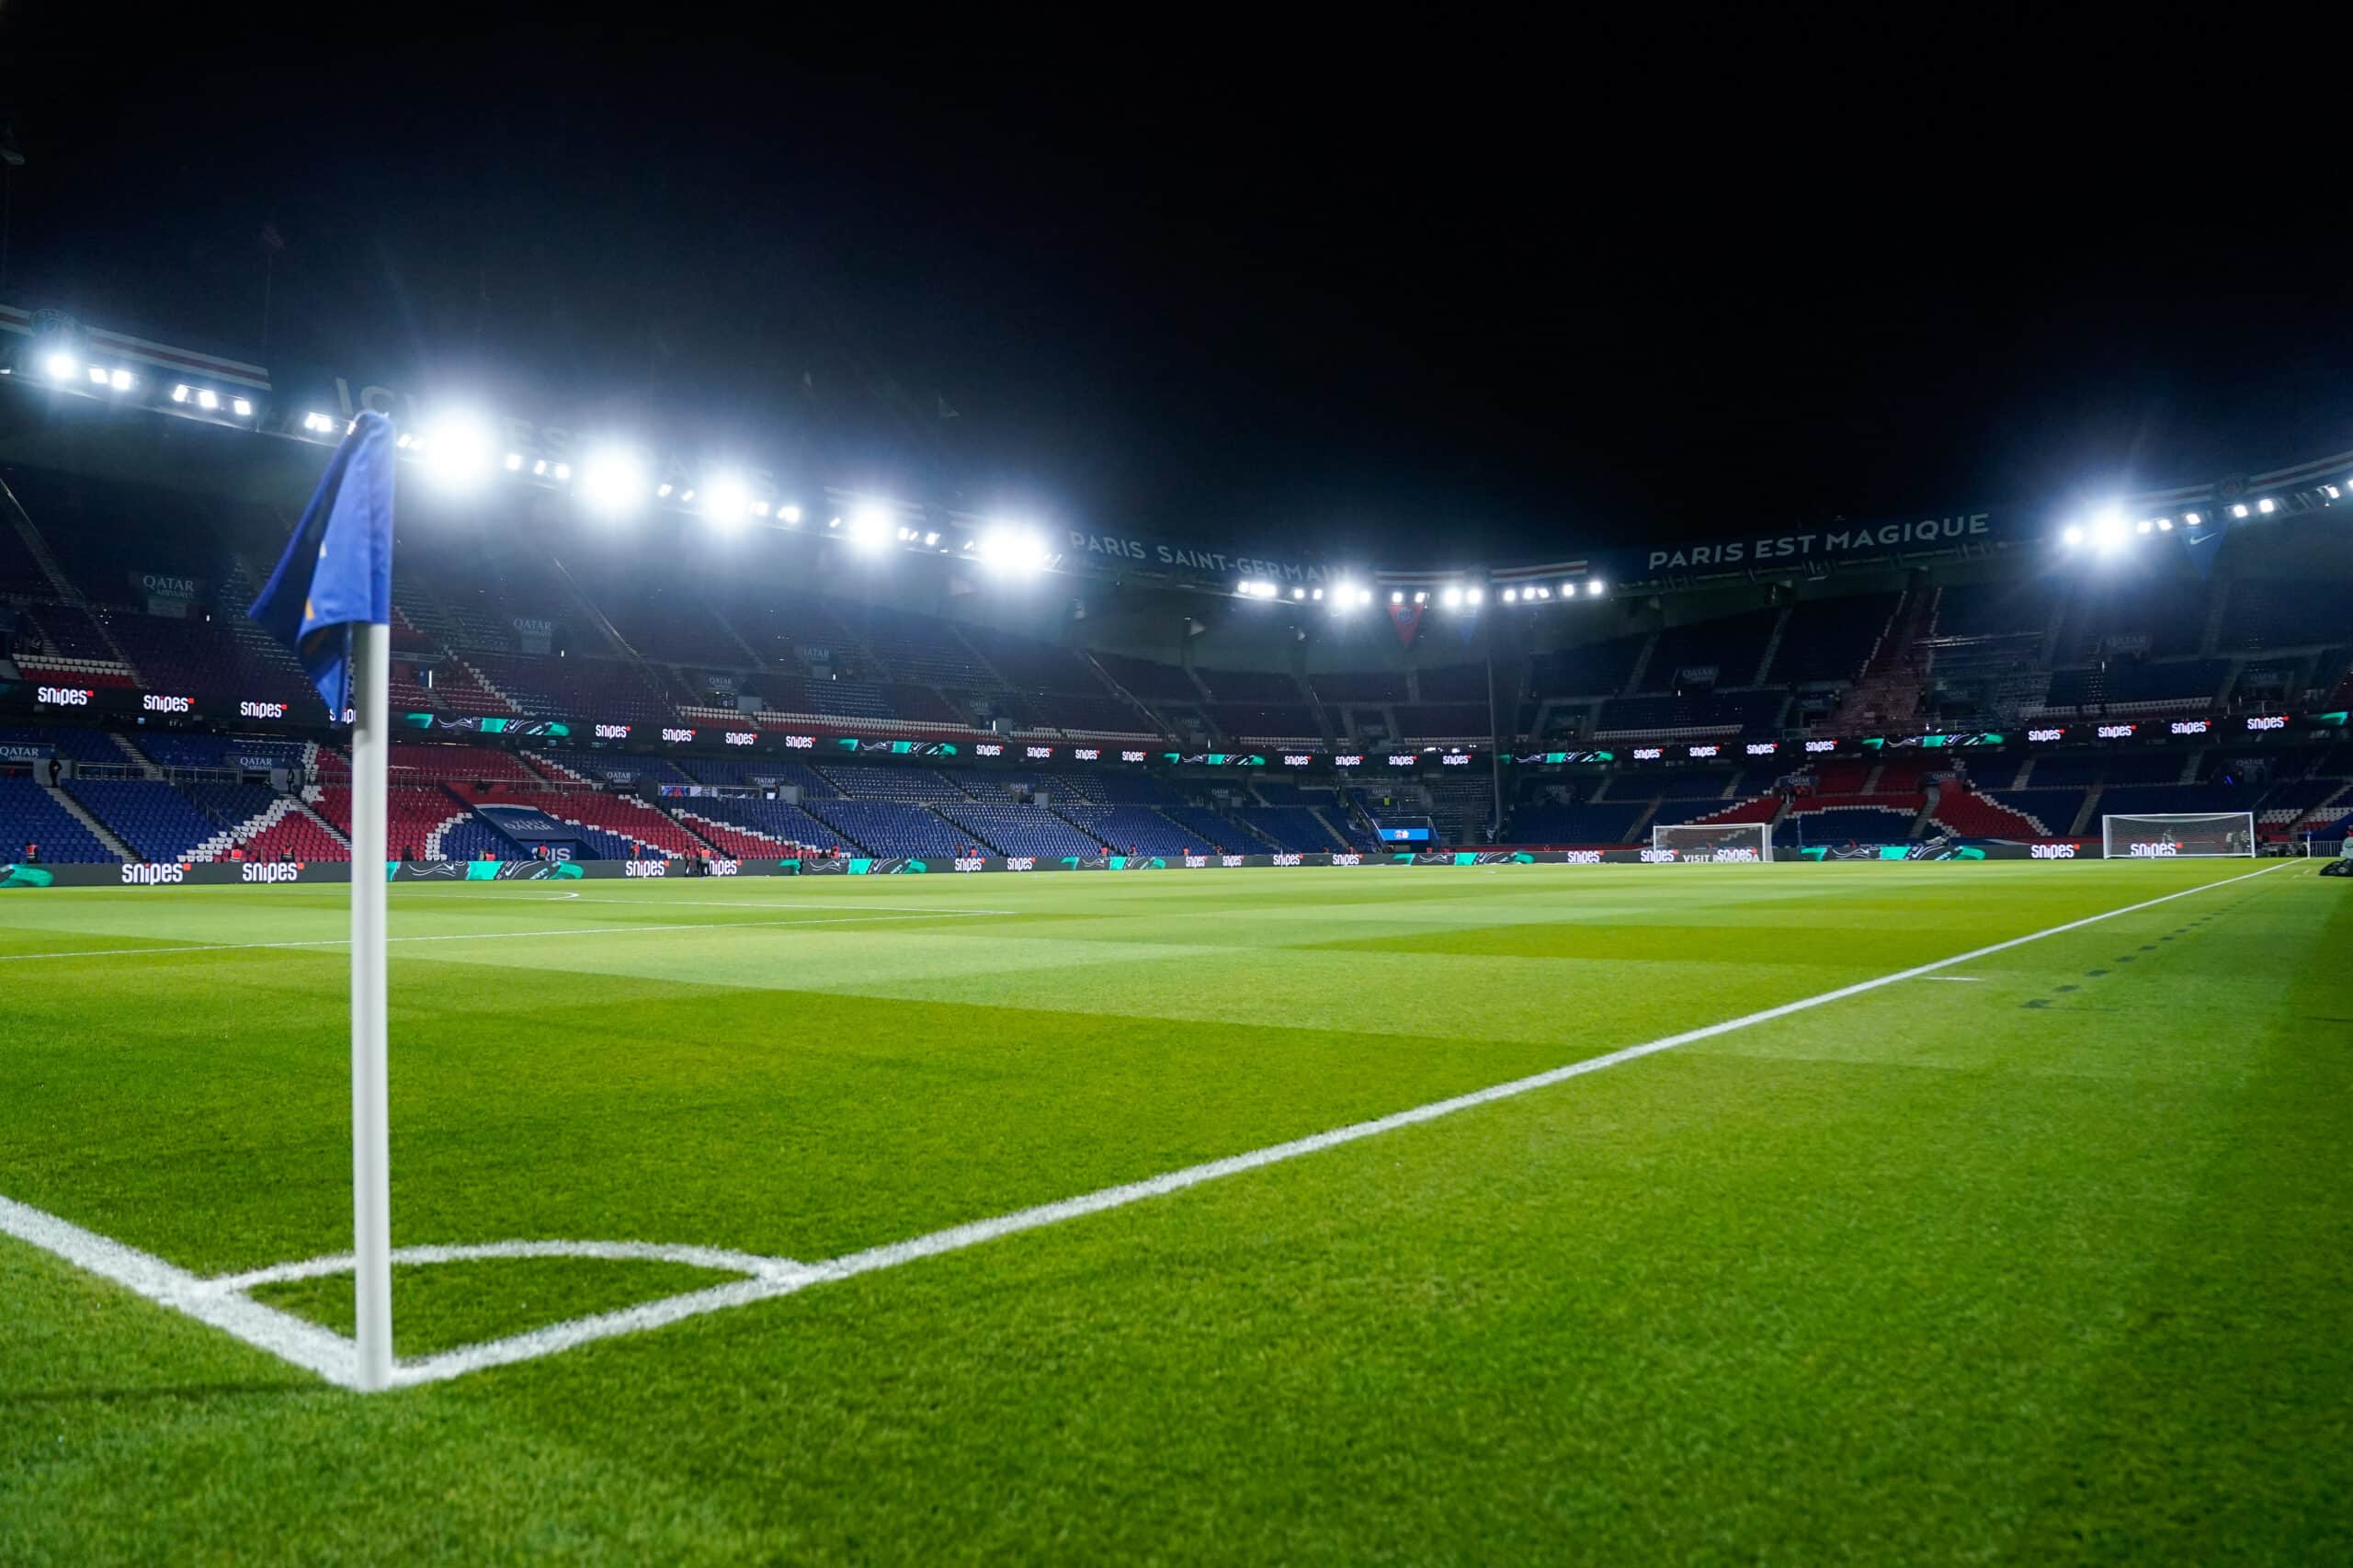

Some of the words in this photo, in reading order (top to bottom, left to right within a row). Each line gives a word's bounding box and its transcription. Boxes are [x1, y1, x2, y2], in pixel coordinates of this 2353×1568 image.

[1070, 529, 1147, 561] PARIS
[1648, 542, 1744, 571] PARIS
[1754, 534, 1817, 560] EST
[1824, 513, 1990, 551] MAGIQUE
[142, 575, 194, 593] QATAR
[513, 618, 552, 632] QATAR
[38, 687, 87, 707] snipes
[143, 694, 188, 713] snipes
[240, 701, 282, 719] snipes
[2171, 721, 2207, 734] snipes
[2247, 716, 2284, 731] snipes
[595, 724, 627, 739] snipes
[662, 728, 692, 744] snipes
[2028, 729, 2061, 742] snipes
[2097, 725, 2132, 738] snipes
[725, 732, 755, 746] snipes
[785, 735, 813, 749] snipes
[0, 746, 39, 758] QATAR
[976, 744, 1001, 756] snipes
[1027, 746, 1051, 759] snipes
[1633, 748, 1661, 760] snipes
[1689, 746, 1717, 757] snipes
[1746, 744, 1775, 756] snipes
[1805, 741, 1835, 753] snipes
[239, 756, 273, 767] QATAR
[1074, 749, 1097, 760] snipes
[1121, 751, 1144, 763] snipes
[1284, 756, 1309, 767] snipes
[1335, 756, 1360, 767] snipes
[1389, 756, 1415, 767] snipes
[1442, 755, 1469, 766] snipes
[606, 771, 631, 780] QATAR
[1567, 849, 1601, 864] snipes
[1640, 848, 1675, 863] snipes
[2030, 844, 2075, 860] snipes
[2130, 843, 2177, 858] snipes
[954, 858, 983, 873] snipes
[1006, 857, 1033, 872] snipes
[1185, 856, 1207, 869] snipes
[1222, 855, 1243, 869] snipes
[1273, 854, 1301, 867] snipes
[1332, 853, 1359, 867] snipes
[1682, 854, 1711, 863] VISIT
[121, 862, 184, 886] snipes
[242, 862, 298, 884] snipes
[625, 859, 665, 878] snipes
[709, 859, 737, 876] nipes
